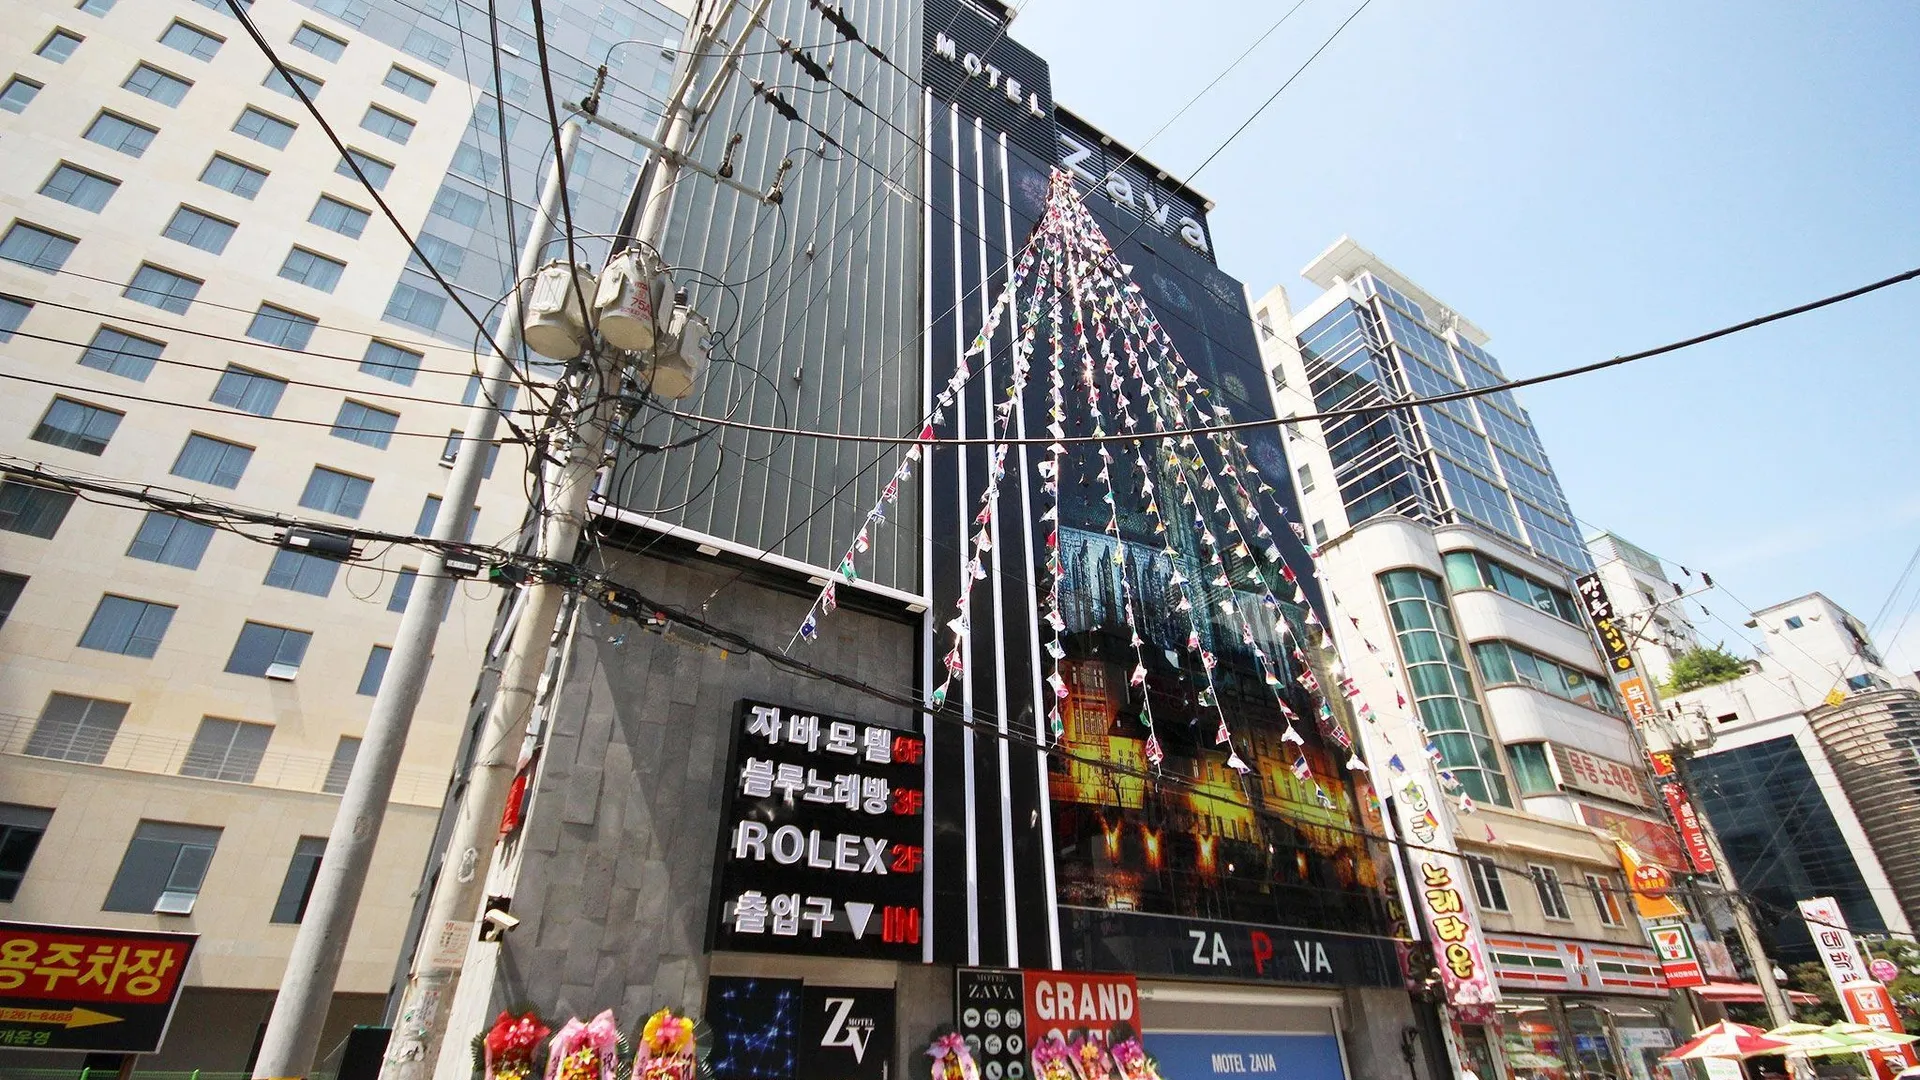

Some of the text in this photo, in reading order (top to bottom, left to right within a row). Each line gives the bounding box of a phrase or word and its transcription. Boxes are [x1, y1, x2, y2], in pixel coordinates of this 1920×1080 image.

[936, 32, 1046, 119] MOTEL
[750, 705, 892, 764] 자바모텔
[742, 756, 923, 815] 블루노래방 3F
[735, 820, 923, 875] ROLEX 2F
[734, 890, 919, 944] 출입구 IN
[1189, 930, 1333, 975] ZA P VA
[968, 984, 1016, 1000] ZAVA
[976, 973, 1007, 983] MOTEL
[1035, 980, 1134, 1021] GRAND
[848, 1018, 875, 1026] MOTEL
[1211, 1053, 1277, 1073] MOTEL ZAVA
